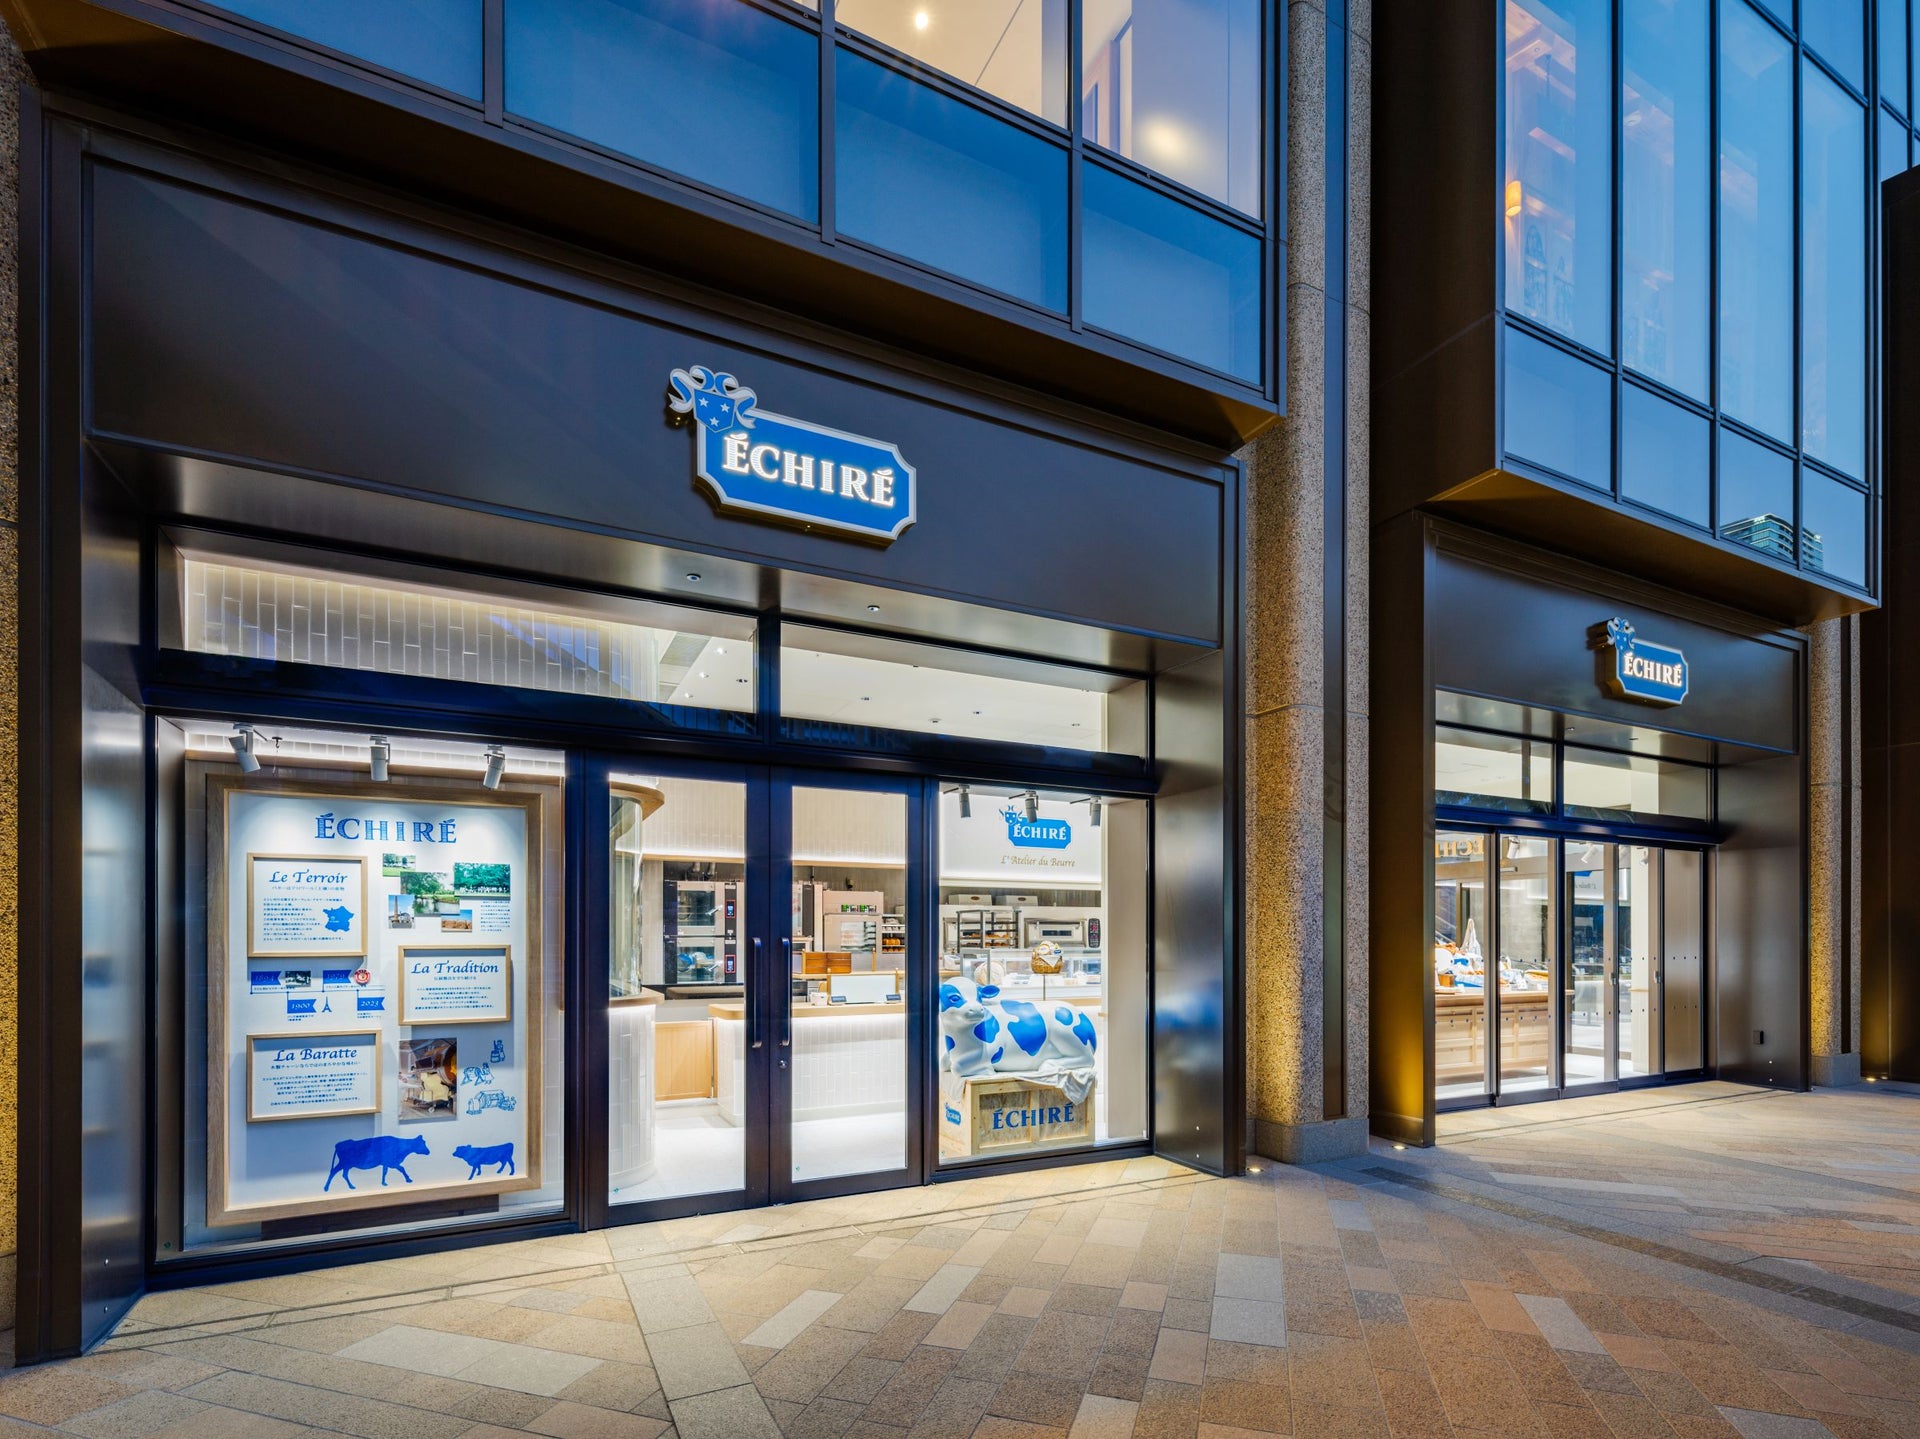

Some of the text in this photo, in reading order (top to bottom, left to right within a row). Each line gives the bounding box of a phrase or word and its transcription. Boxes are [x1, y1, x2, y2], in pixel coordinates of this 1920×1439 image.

[723, 433, 895, 507] ÉCHIRÉ
[1623, 651, 1683, 687] ÉCHIRÉ
[314, 812, 457, 844] ÉCHIRÉ
[1013, 824, 1067, 841] ÉCHIRÉ
[1038, 855, 1048, 866] du
[1051, 857, 1076, 867] Beurre
[269, 868, 348, 884] Le Terroir
[411, 960, 499, 974] La Tradition
[273, 1048, 358, 1062] La Baratte
[992, 1102, 1075, 1130] ÉCHIRÉ
